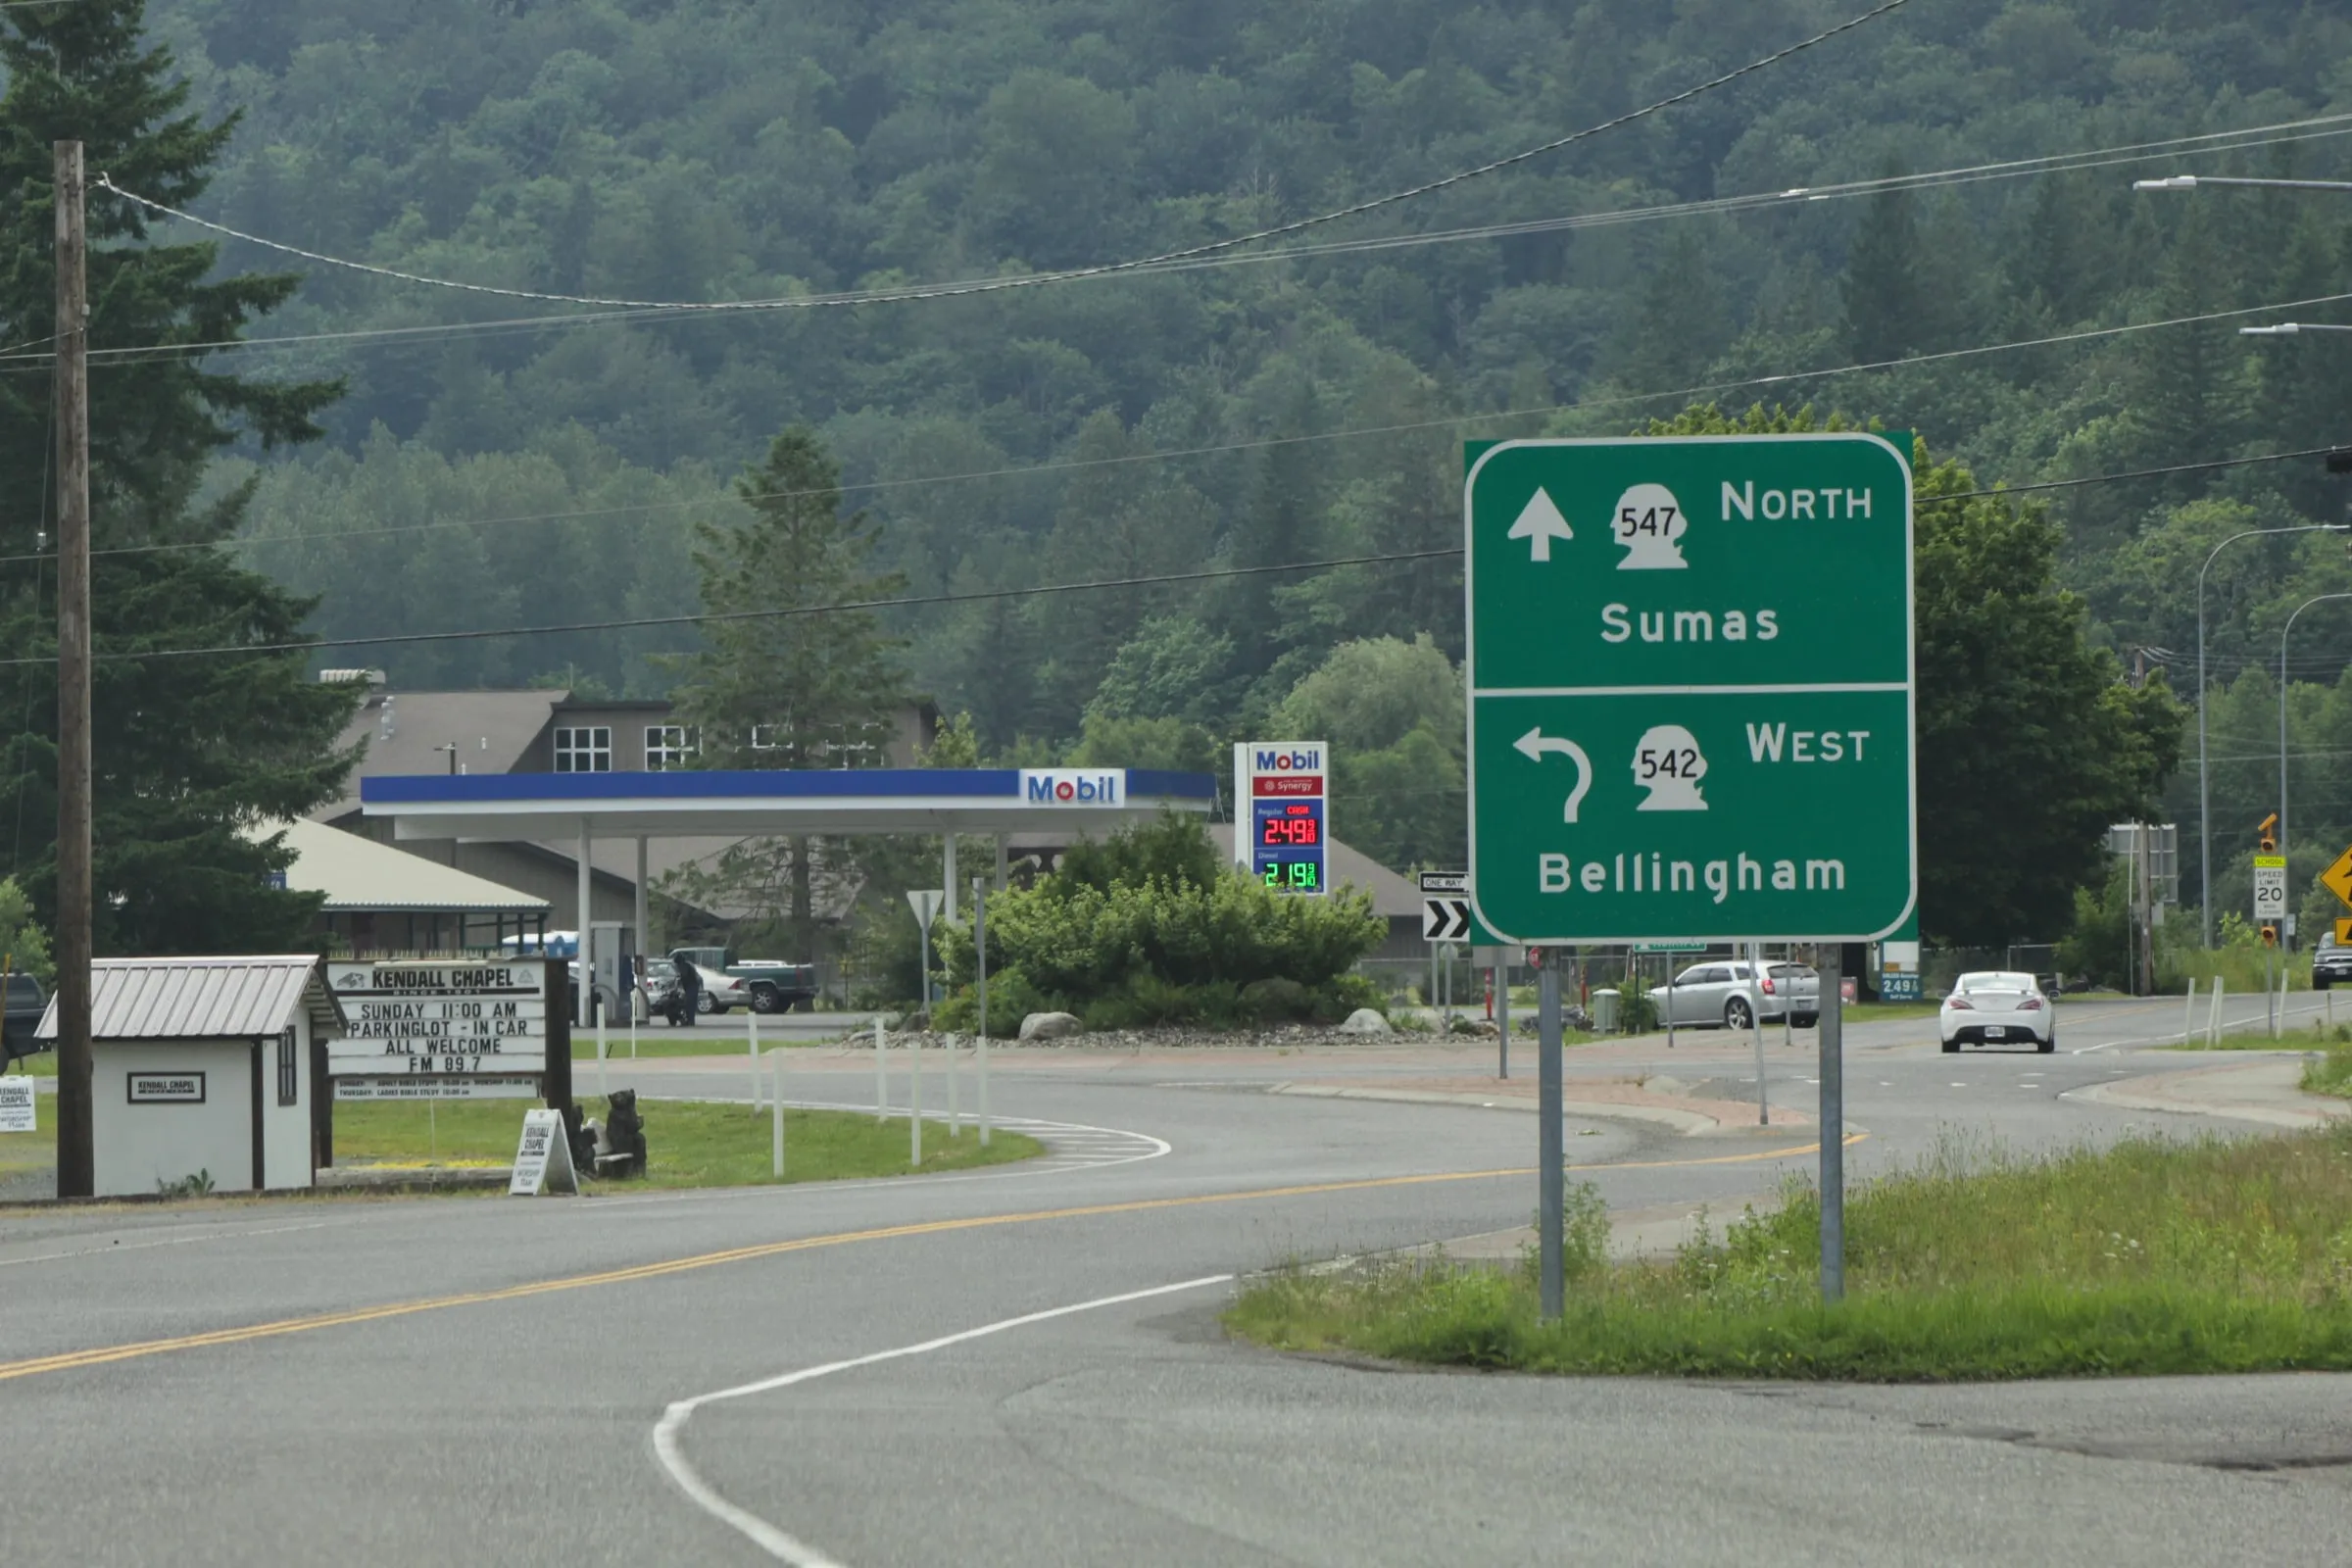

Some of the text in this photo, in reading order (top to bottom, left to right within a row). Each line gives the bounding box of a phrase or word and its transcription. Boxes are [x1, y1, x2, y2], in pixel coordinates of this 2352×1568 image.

[1621, 480, 1871, 537] 547 NORTH
[1600, 603, 1779, 643] Sumas
[1641, 722, 1870, 779] 542 WEST
[1256, 750, 1319, 770] Mobil
[1027, 776, 1114, 801] Mobil
[1277, 780, 1313, 792] Synergy
[1264, 819, 1307, 844] 2.49
[1425, 878, 1463, 887] ONE WAY
[1540, 851, 1845, 905] Bellingham
[2258, 887, 2282, 902] 20
[371, 968, 514, 989] KENDALL CHAPEL
[1884, 980, 1910, 993] 2.49
[362, 1002, 516, 1020] SUNDAY 11:00 AM
[350, 1021, 451, 1038] PARKINGLOT
[473, 1020, 488, 1036] IN
[496, 1020, 527, 1036] CAR
[386, 1038, 501, 1055] ALL WELCOME
[410, 1055, 481, 1074] FM 89.7
[170, 1080, 195, 1089] CHAPEL
[1, 1095, 26, 1103] CHAPEL
